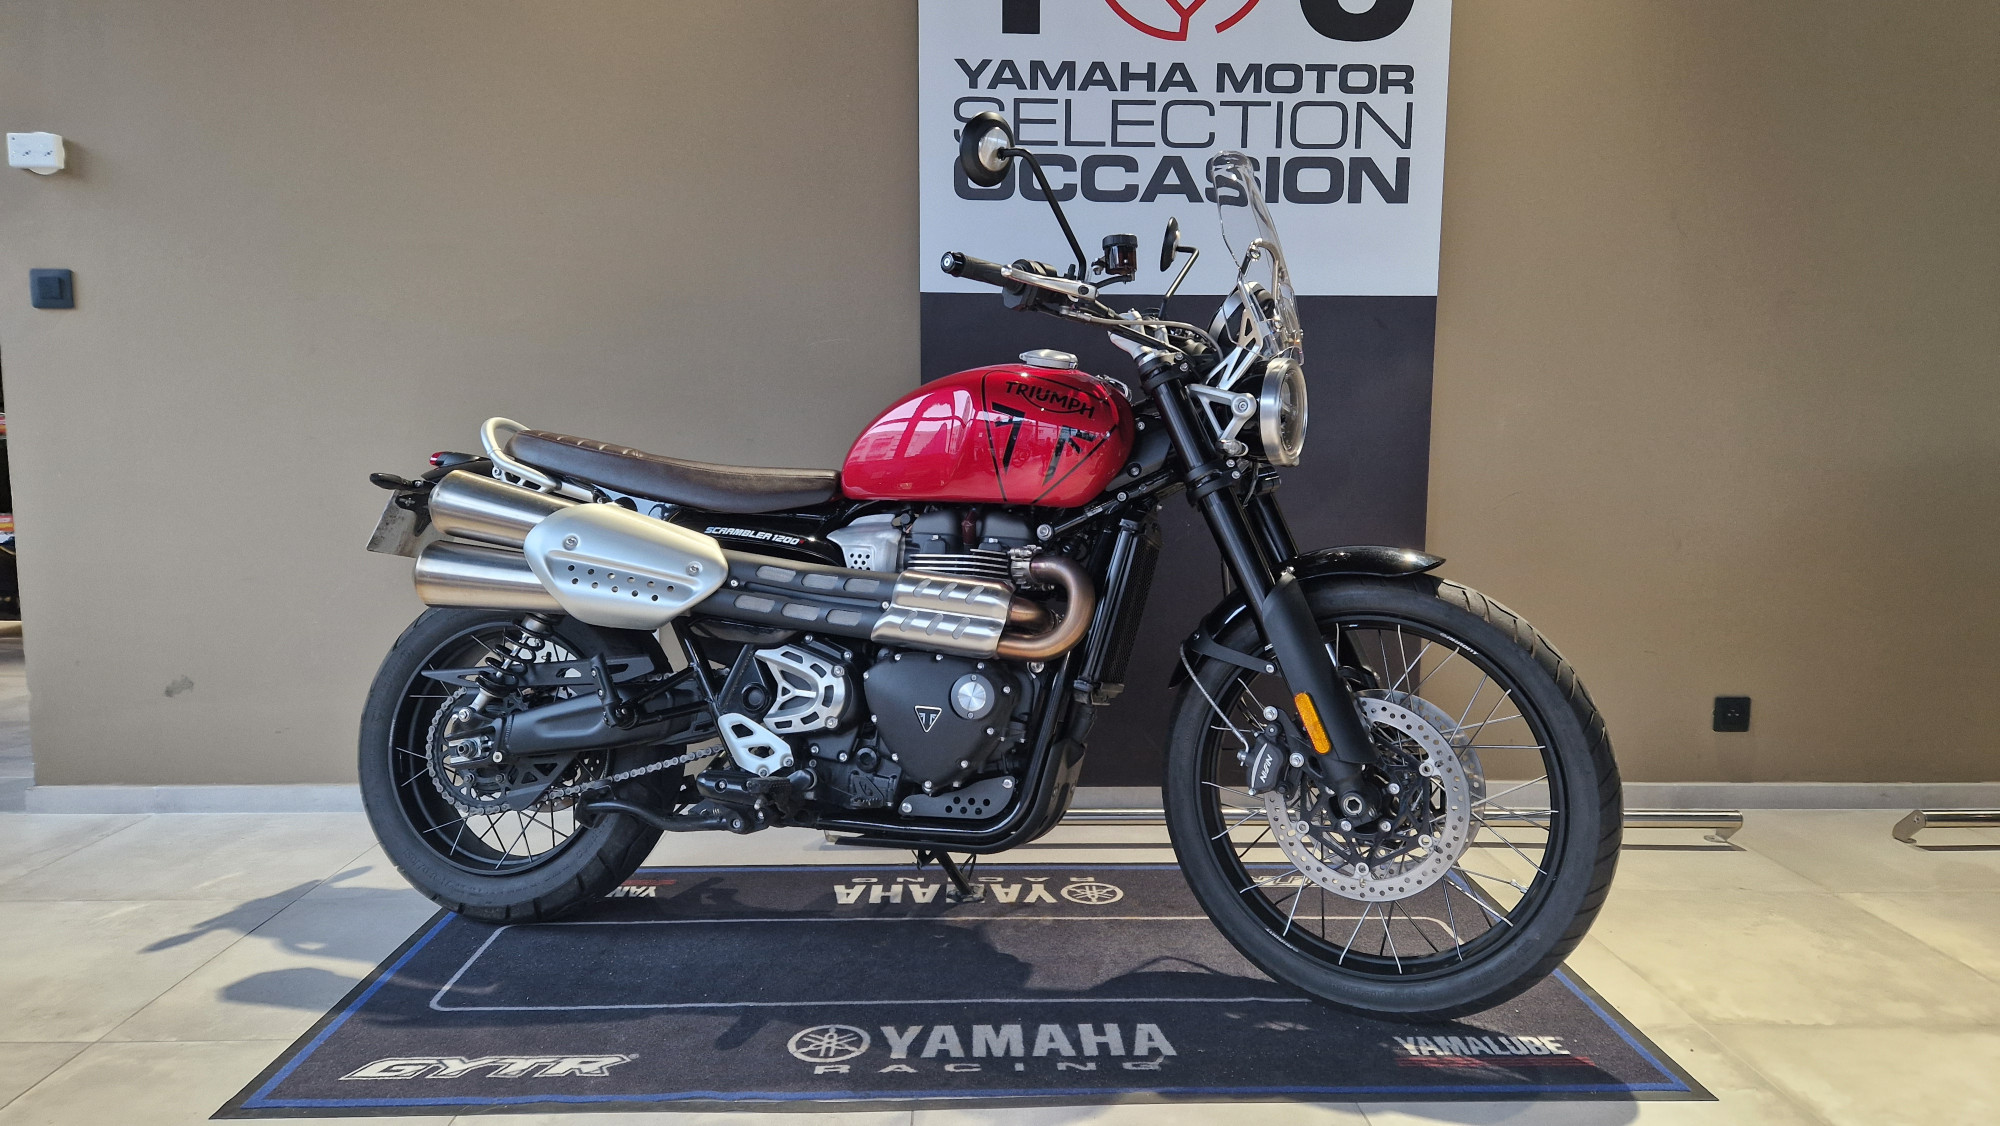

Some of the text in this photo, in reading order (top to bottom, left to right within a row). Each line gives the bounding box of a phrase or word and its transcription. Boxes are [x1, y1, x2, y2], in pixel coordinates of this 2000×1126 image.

[954, 58, 1414, 95] YAMAHA MOTOR
[953, 96, 1413, 150] SELECTION
[953, 153, 1409, 207] OCCASION
[1004, 380, 1095, 420] TRIUMPH
[704, 526, 773, 540] SCRAMBLER
[880, 1023, 1178, 1059] YAMAHA
[1392, 1036, 1571, 1056] YAMALUBE
[338, 1054, 632, 1081] GYTR
[813, 1057, 1167, 1075] RACING
